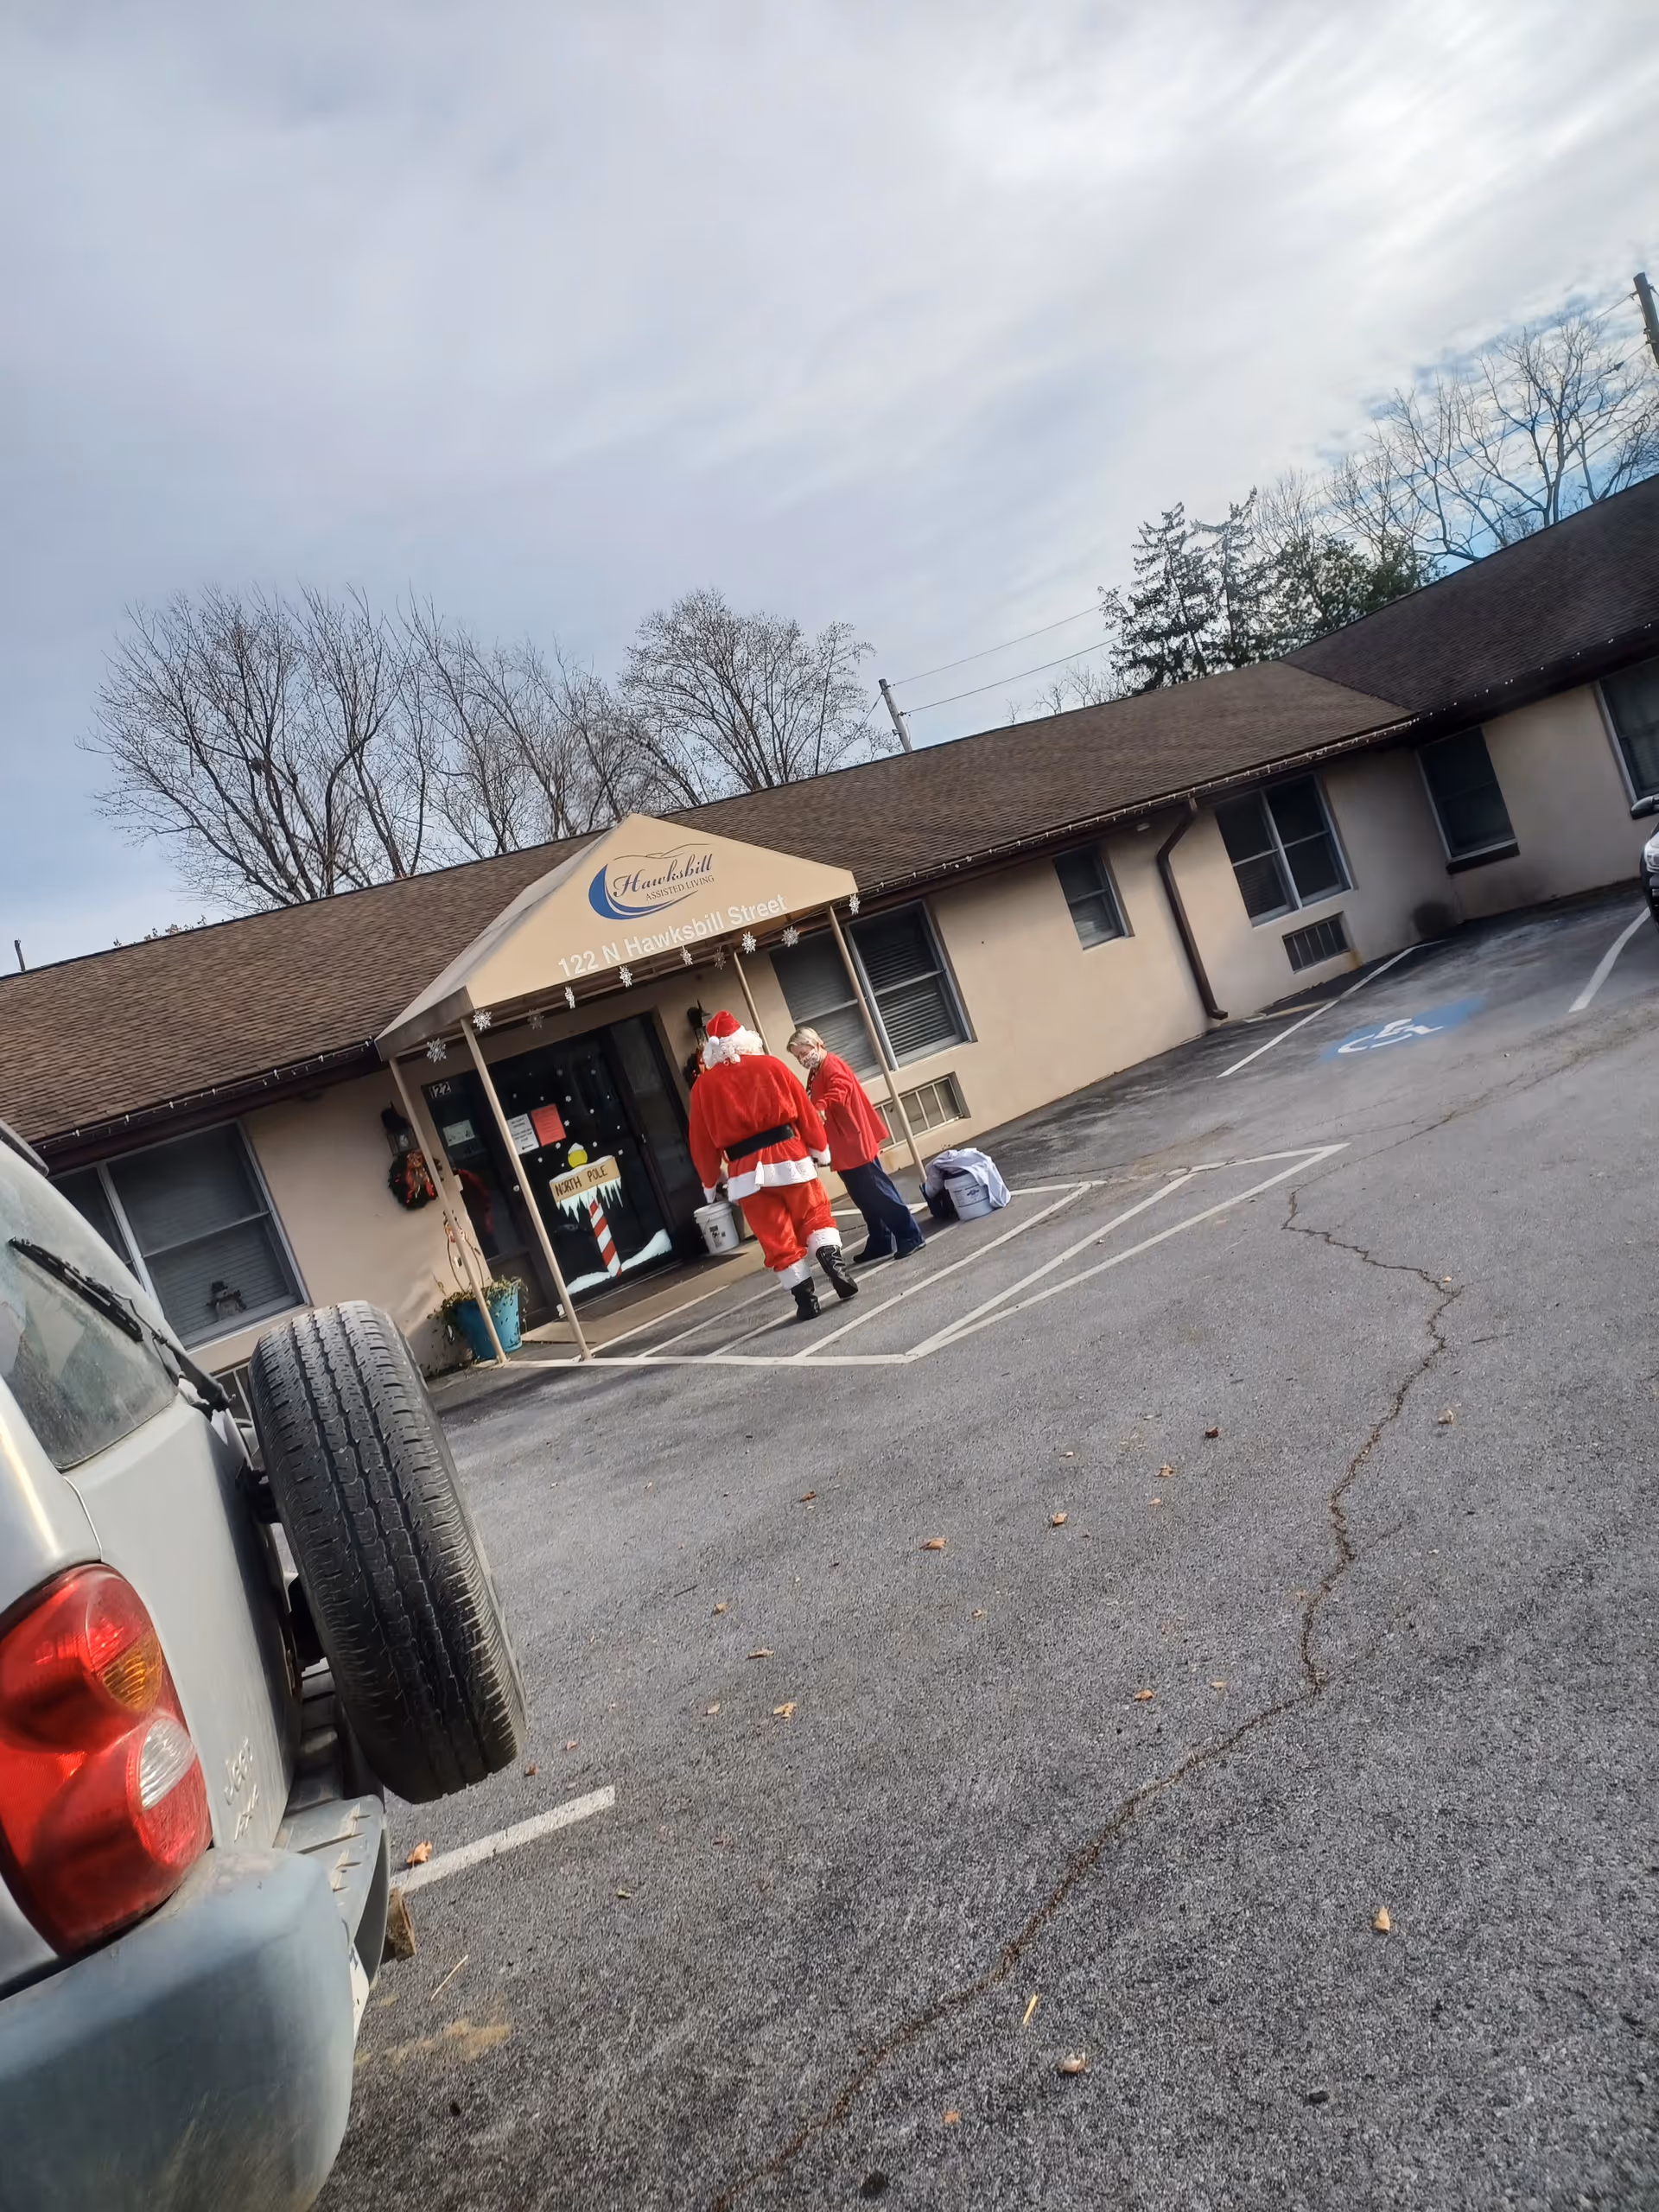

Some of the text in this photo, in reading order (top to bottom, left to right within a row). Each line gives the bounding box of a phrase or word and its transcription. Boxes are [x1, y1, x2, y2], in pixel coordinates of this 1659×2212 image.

[613, 854, 713, 898] Hawksbill
[646, 874, 715, 901] ASSISTED LIVING
[558, 893, 787, 978] 122 N Hawksbill Street
[429, 1082, 451, 1099] 122
[555, 1165, 608, 1197] NORTH POLE
